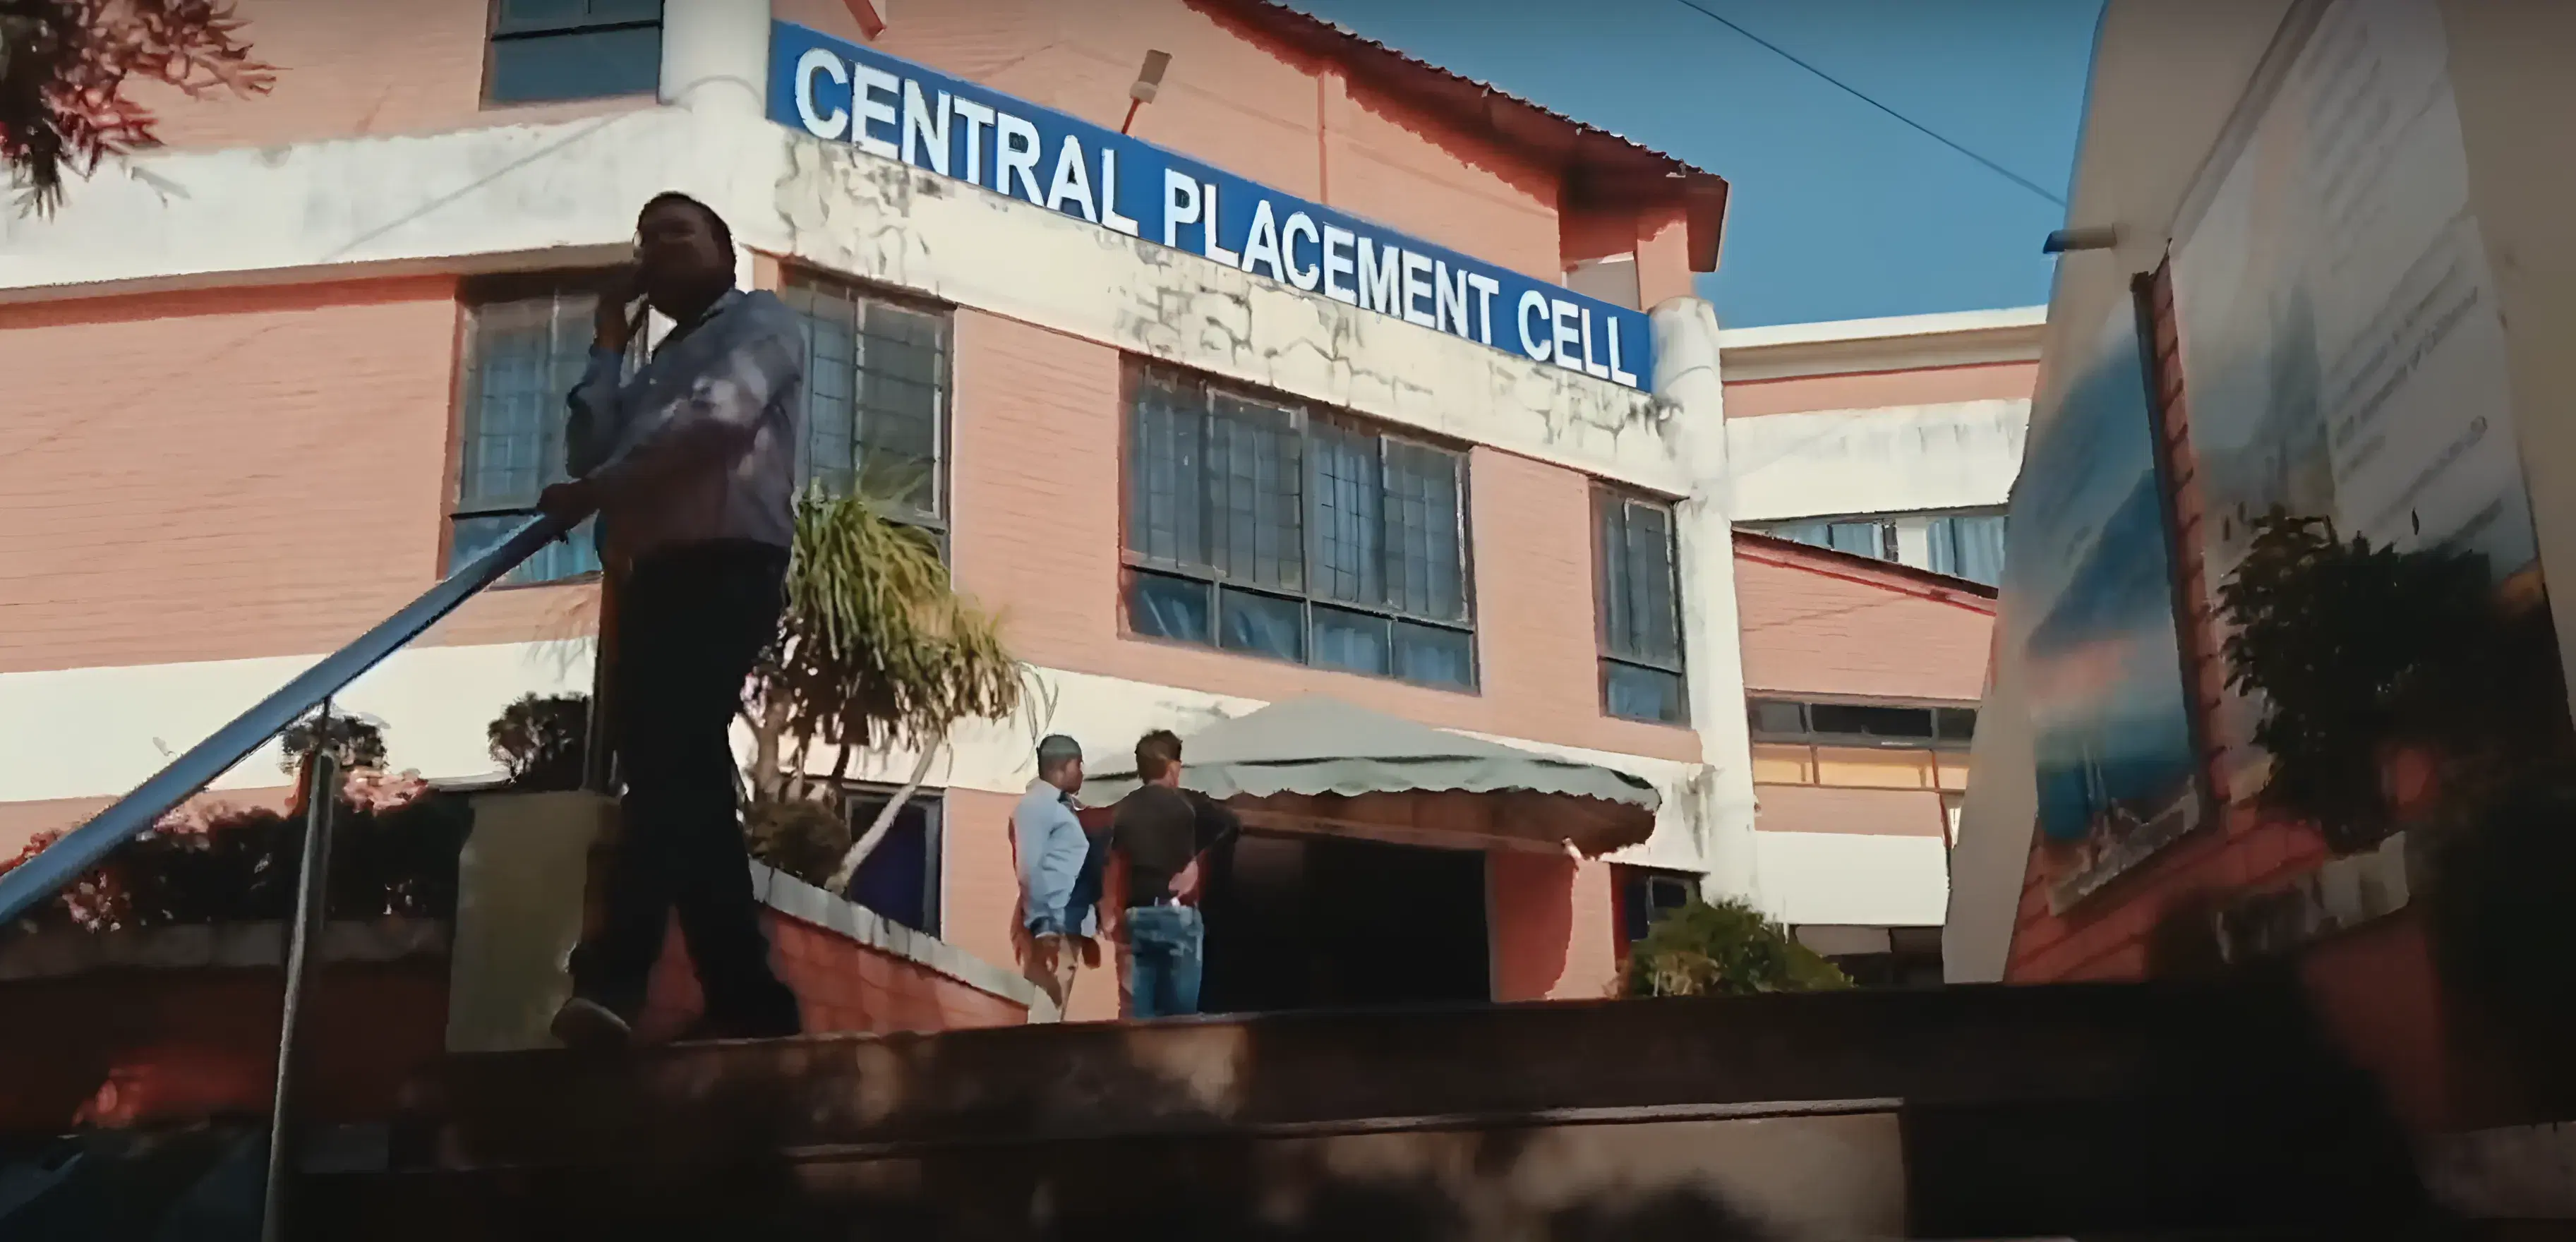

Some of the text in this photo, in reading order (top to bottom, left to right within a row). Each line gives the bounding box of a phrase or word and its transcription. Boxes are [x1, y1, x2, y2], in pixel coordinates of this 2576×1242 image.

[795, 47, 1638, 387] CENTRAL PLACEMENT CELL
